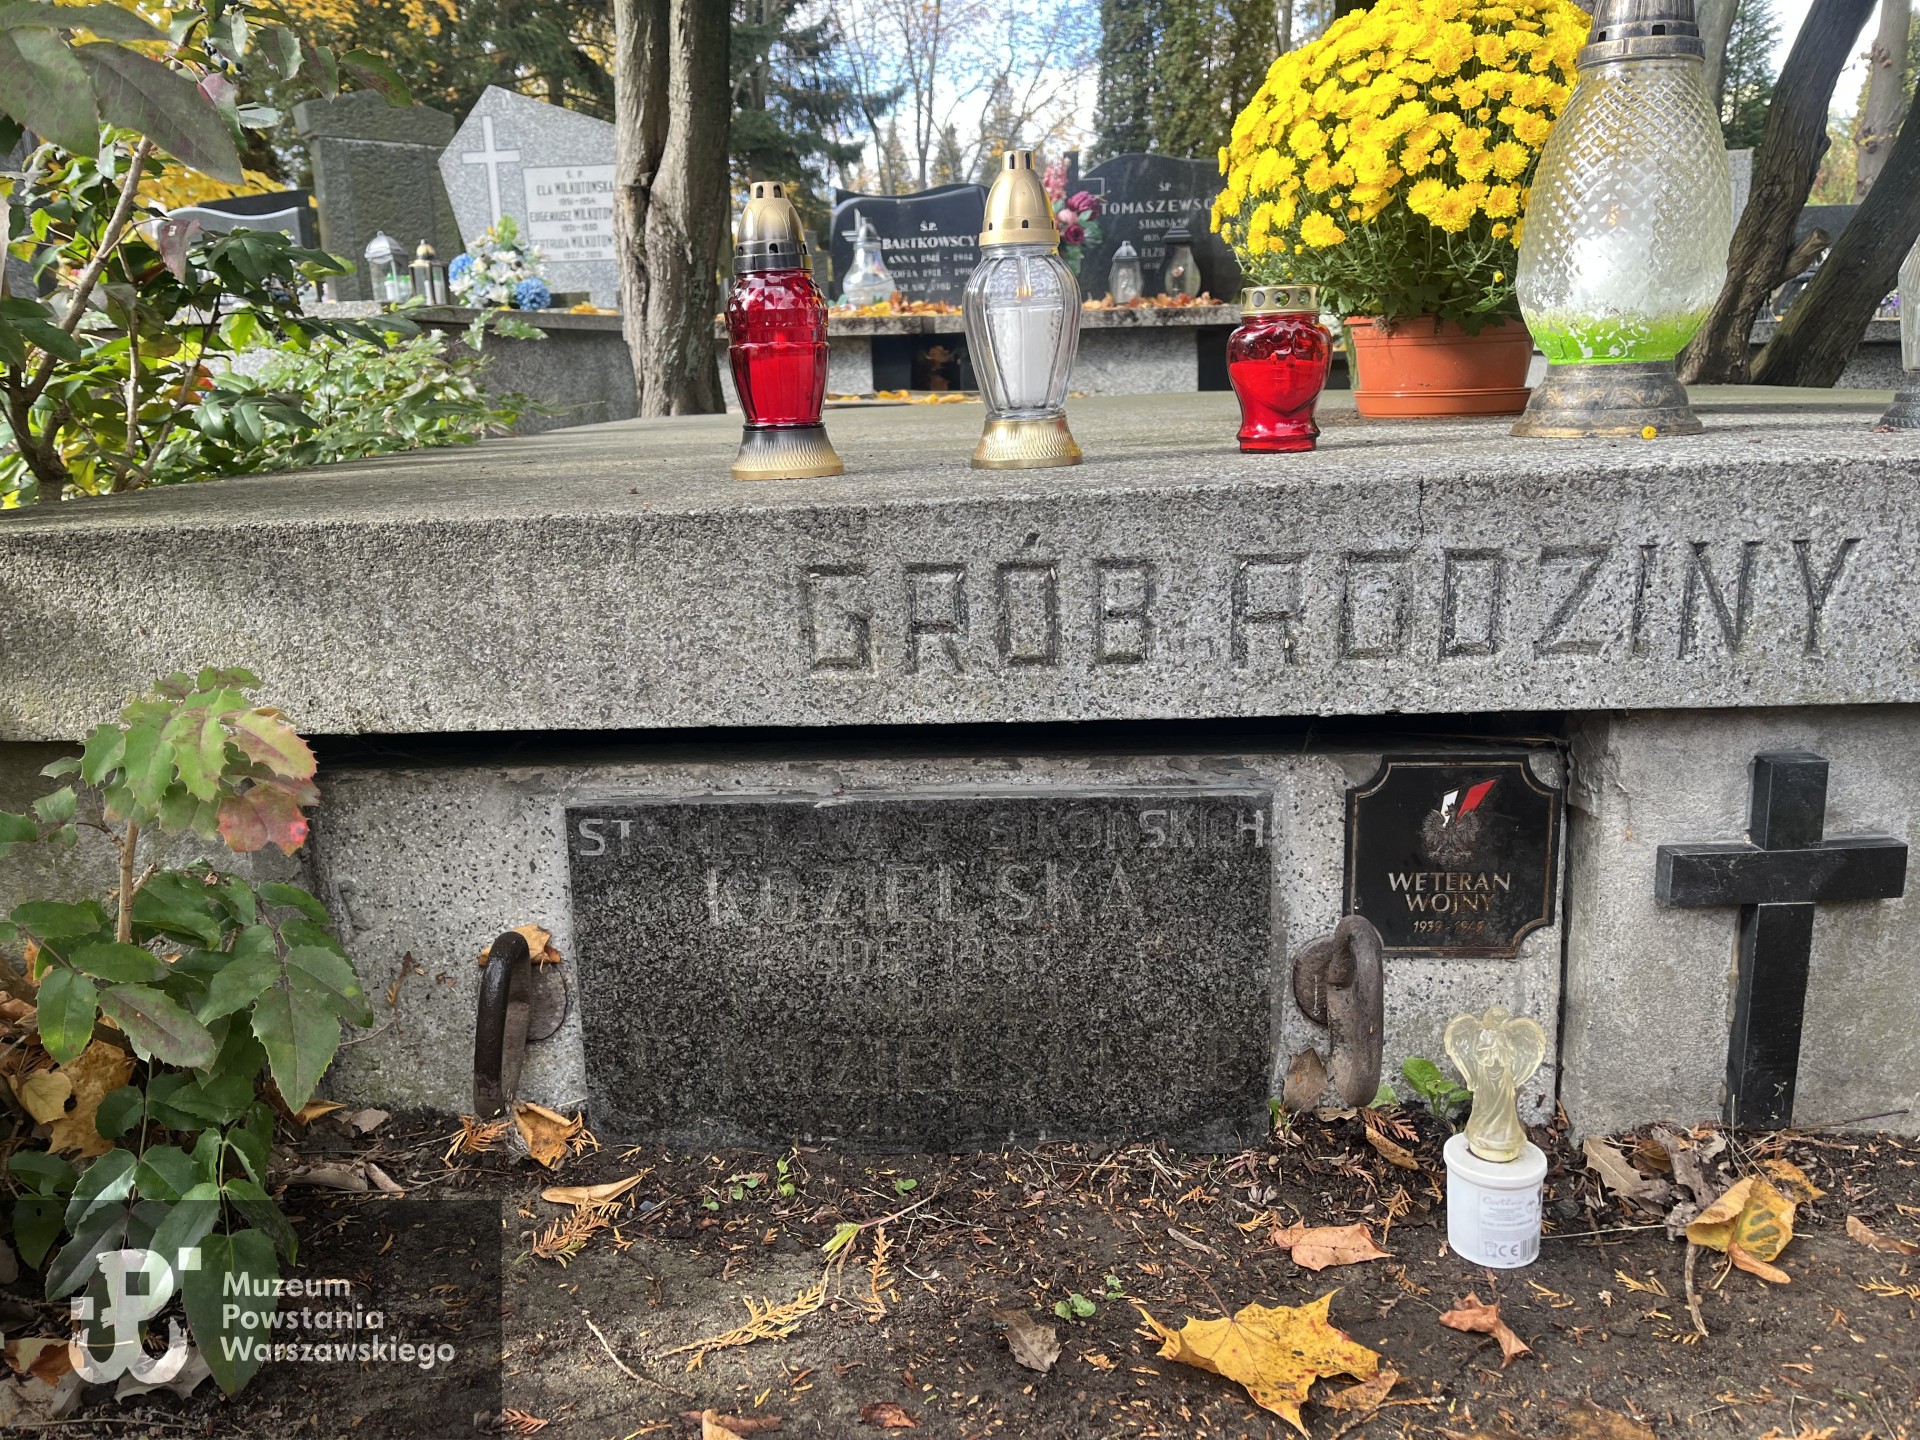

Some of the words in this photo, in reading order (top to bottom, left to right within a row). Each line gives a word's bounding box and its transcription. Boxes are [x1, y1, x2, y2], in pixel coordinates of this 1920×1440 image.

[1101, 197, 1212, 216] TOMASZEWSC
[882, 235, 977, 250] BARTKOWSCY
[800, 532, 1155, 674] GRÓB
[1231, 538, 1862, 664] RODZINY
[1388, 872, 1512, 892] WETERAN
[1405, 893, 1497, 914] WOJNY
